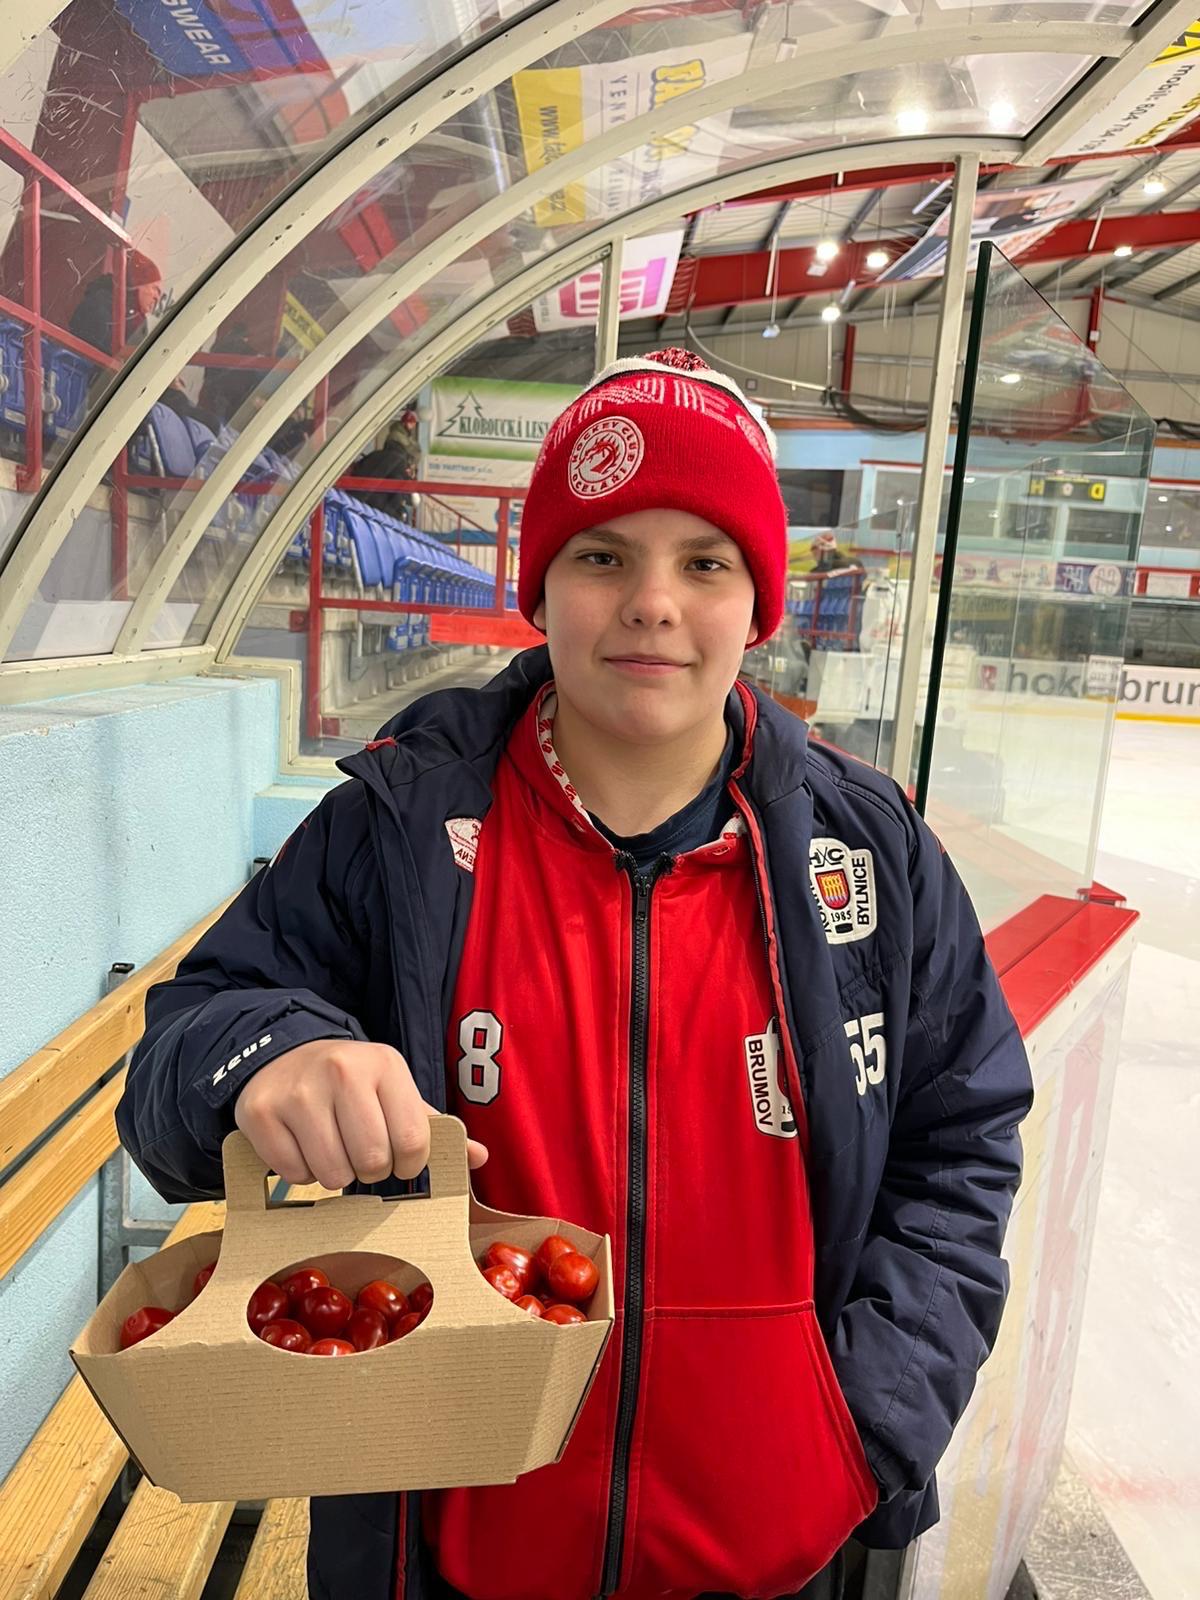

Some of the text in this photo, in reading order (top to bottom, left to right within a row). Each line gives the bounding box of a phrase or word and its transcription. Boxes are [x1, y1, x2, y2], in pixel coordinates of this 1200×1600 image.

[571, 421, 637, 463] HOCKEY CLUB
[830, 910, 852, 923] 1985
[851, 857, 870, 926] BYLNICE
[212, 1033, 273, 1087] zeus
[458, 1008, 503, 1106] 8
[748, 1039, 773, 1126] BRUMOV
